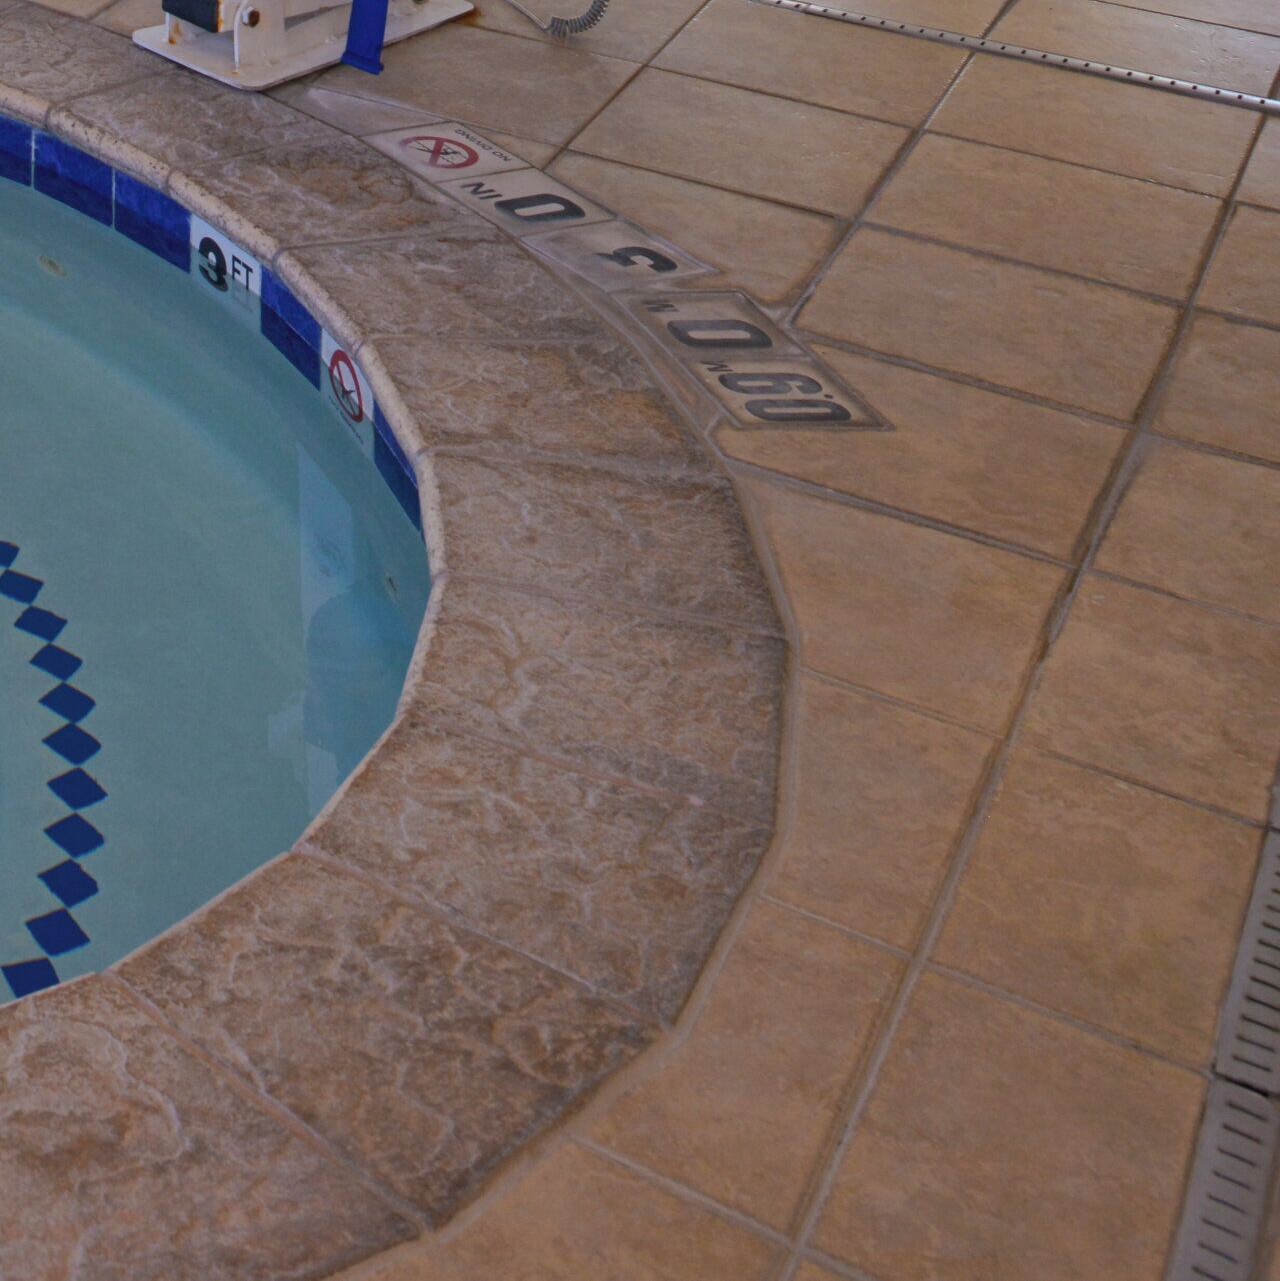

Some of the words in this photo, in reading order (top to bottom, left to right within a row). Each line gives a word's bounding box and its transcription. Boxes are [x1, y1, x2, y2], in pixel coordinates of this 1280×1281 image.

[454, 128, 490, 153] DIVING
[491, 150, 512, 162] NO
[460, 181, 503, 200] IN
[231, 255, 254, 290] FT
